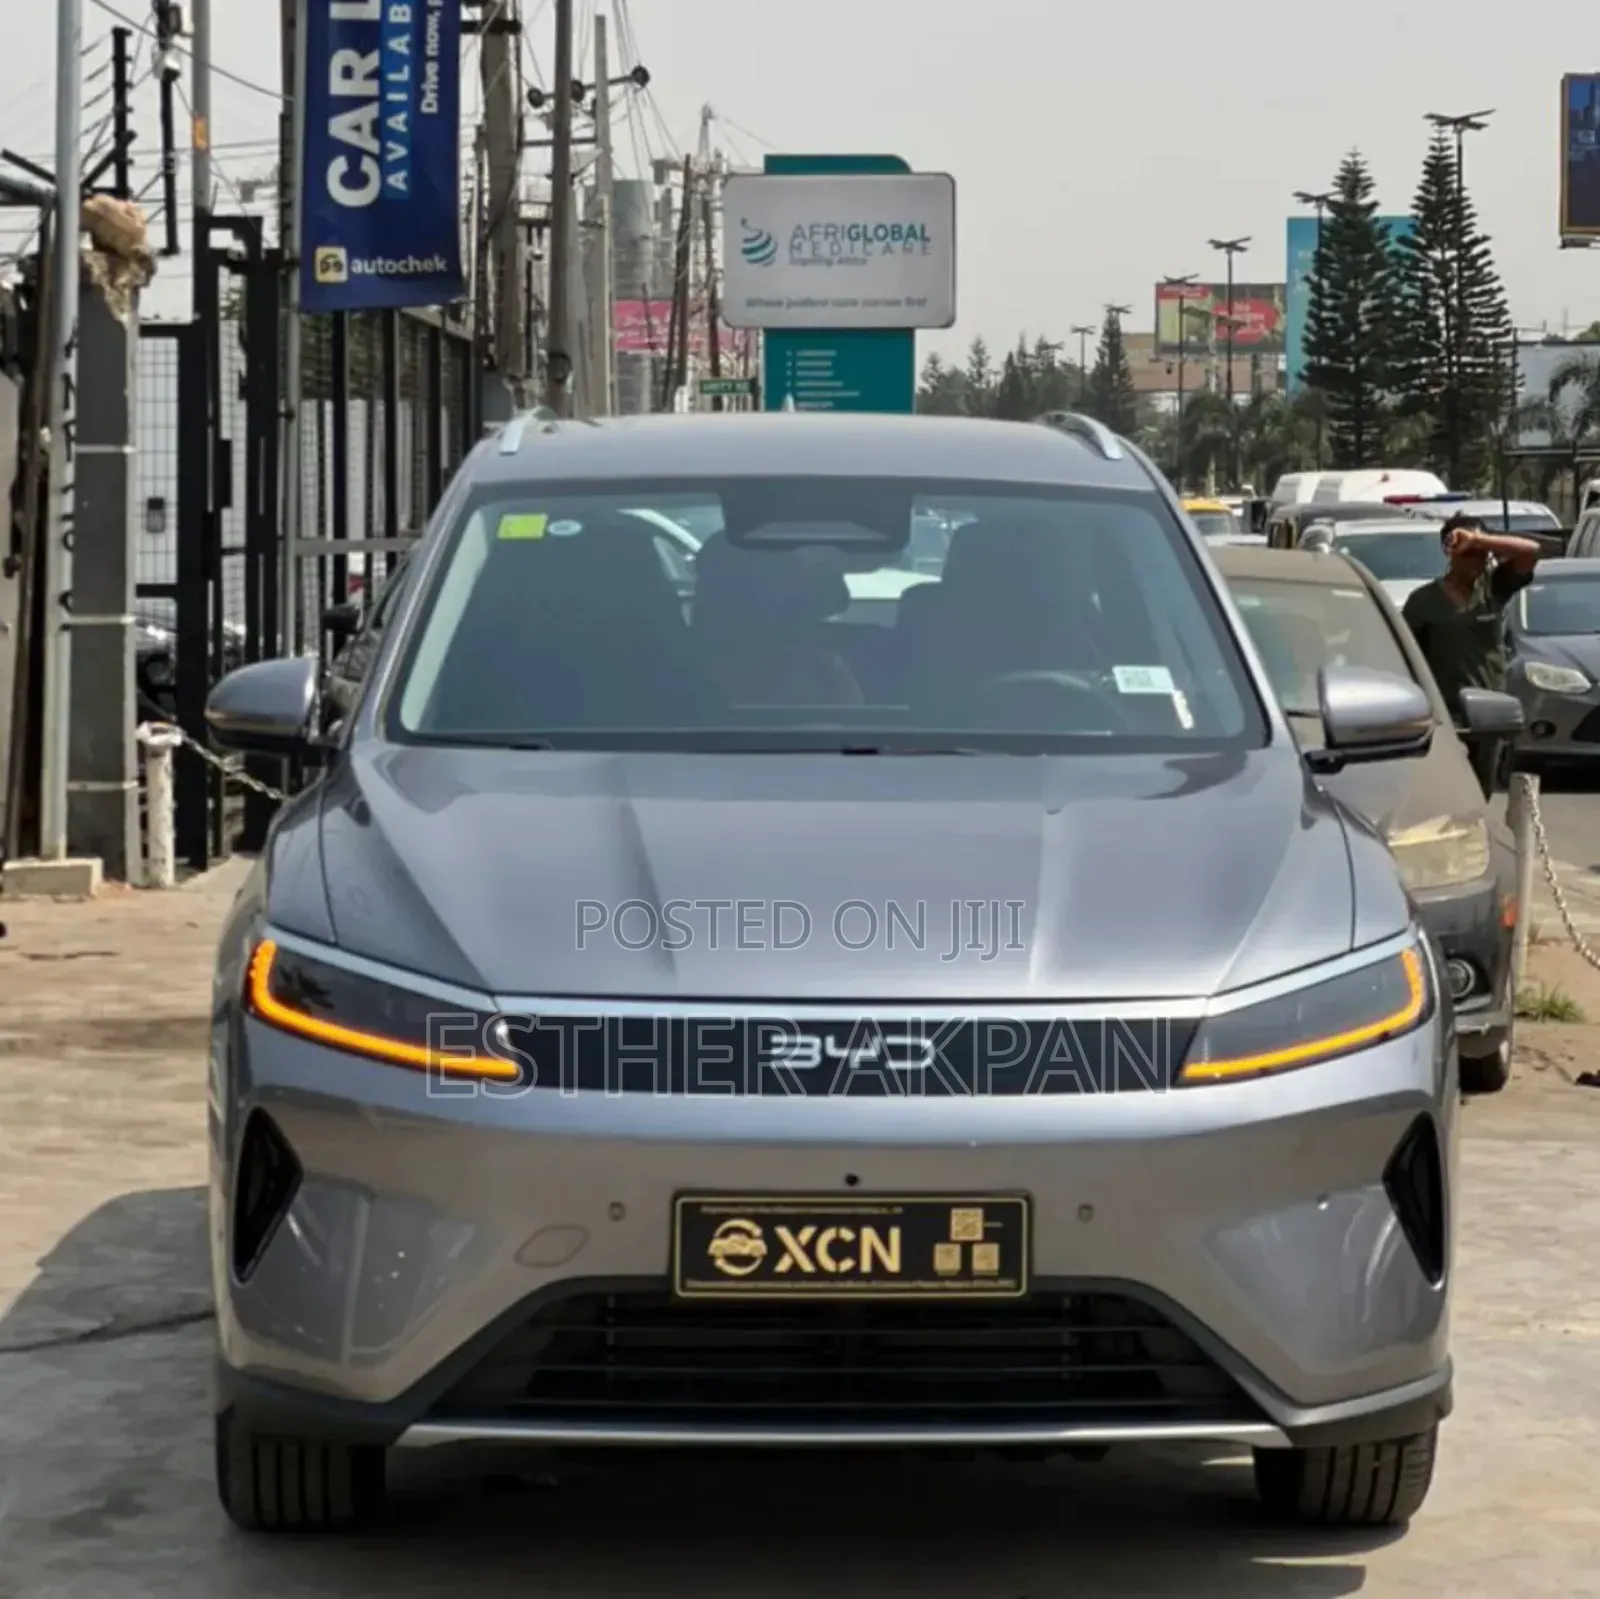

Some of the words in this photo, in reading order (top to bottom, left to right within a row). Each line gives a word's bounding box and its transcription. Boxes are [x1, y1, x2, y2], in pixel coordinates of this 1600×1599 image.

[386, 3, 412, 192] AVAILAB
[420, 61, 439, 115] Drive
[326, 48, 382, 208] CAR
[791, 222, 932, 243] AFRIGLOBAL
[350, 254, 449, 275] autochek
[770, 1034, 937, 1070] BYD
[774, 1225, 902, 1274] XCN
